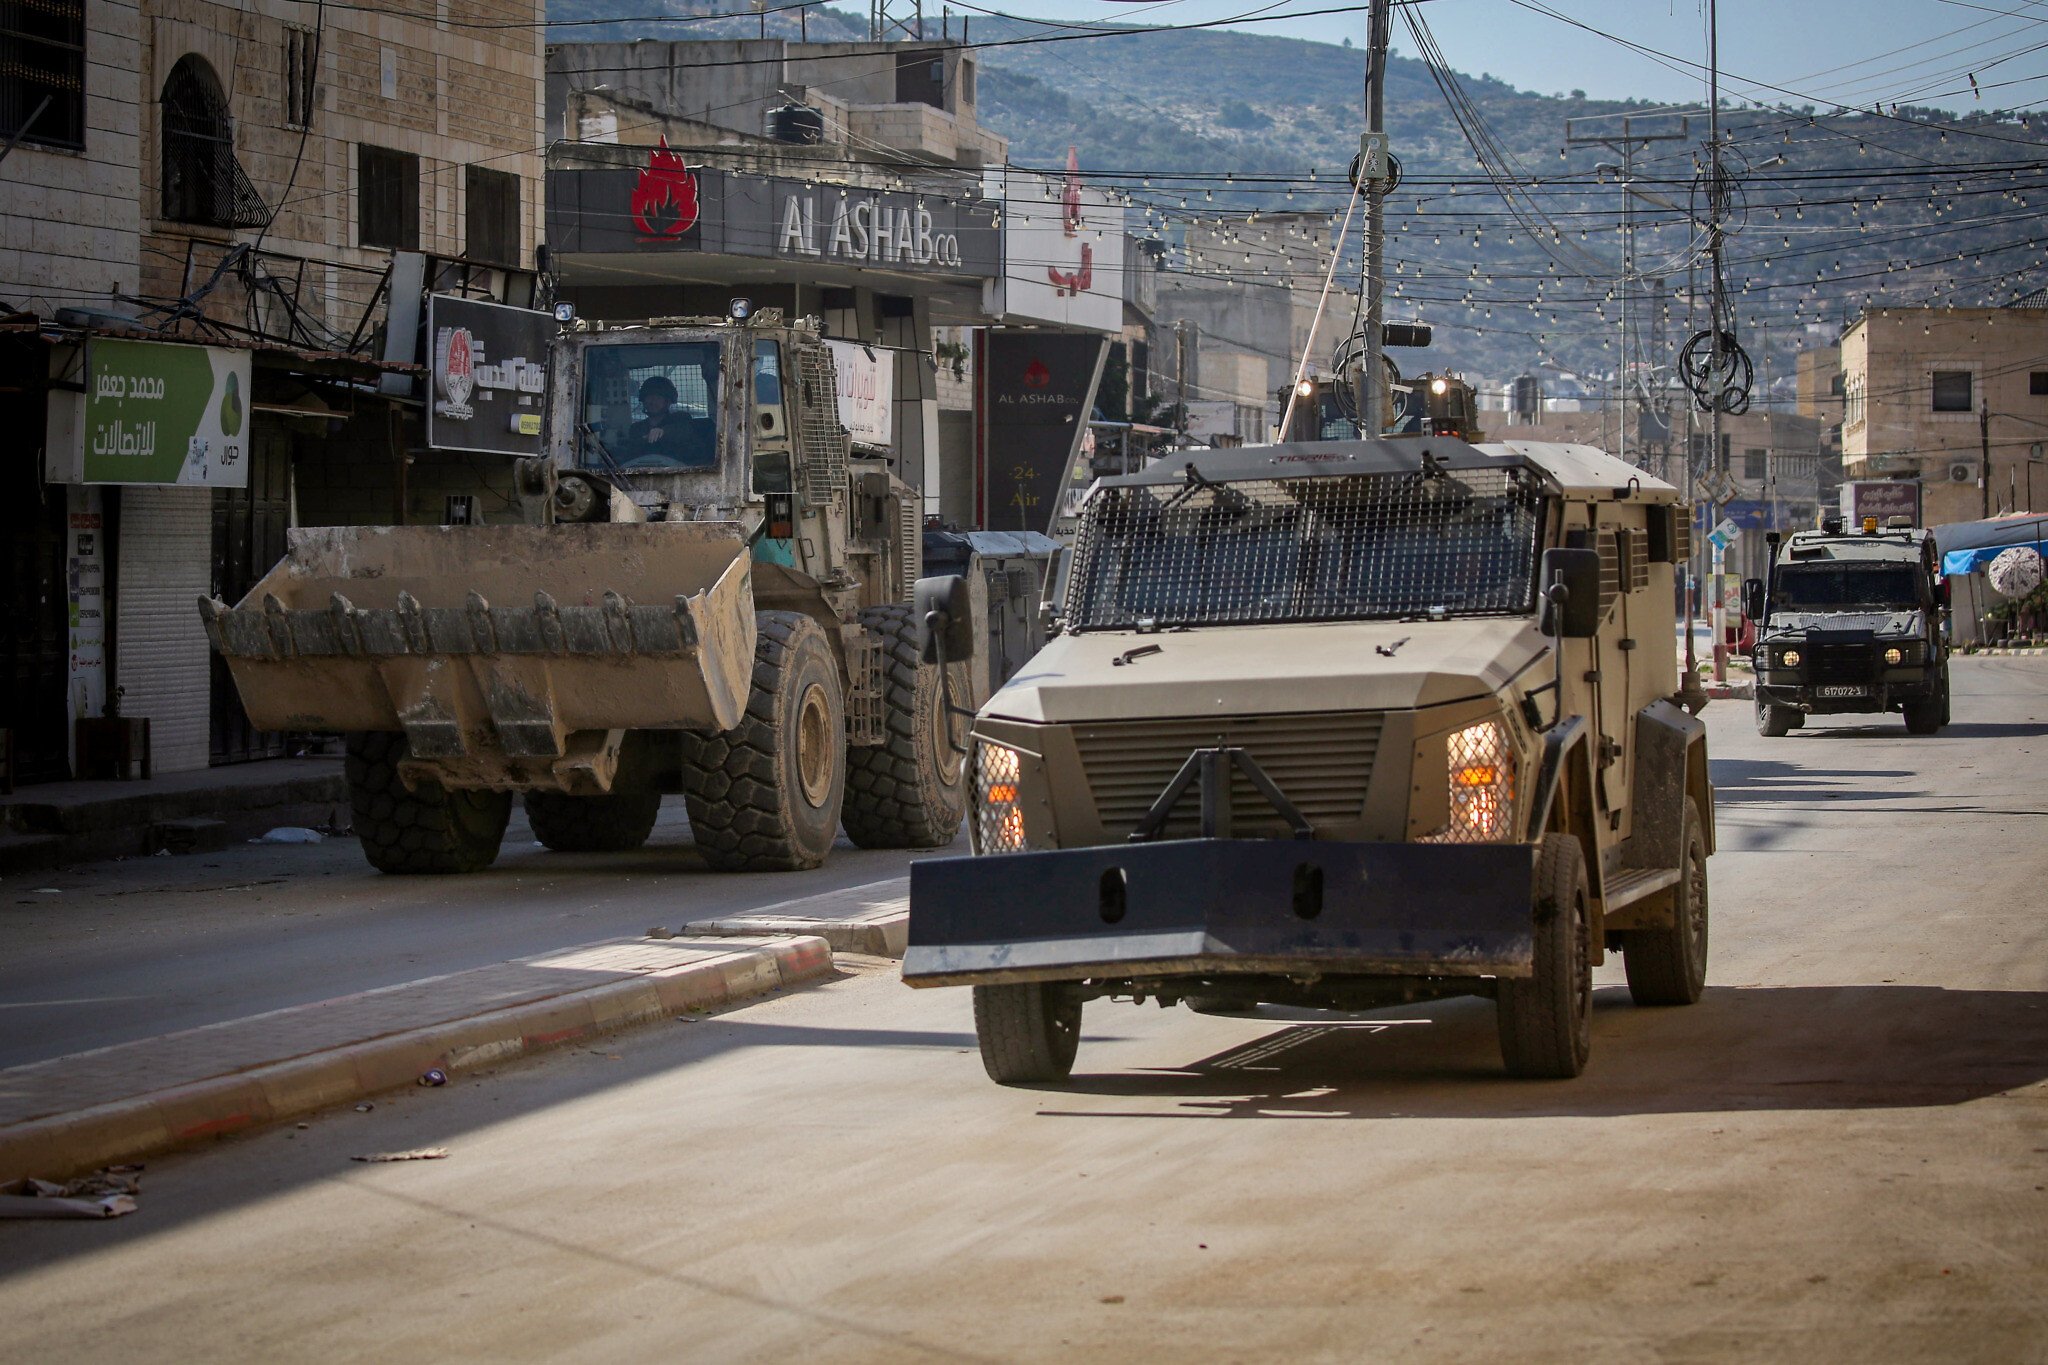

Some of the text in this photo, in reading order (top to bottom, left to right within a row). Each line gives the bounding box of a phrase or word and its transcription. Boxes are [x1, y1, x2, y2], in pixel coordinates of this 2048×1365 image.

[778, 195, 821, 256] AL
[94, 364, 165, 408] محمد جعفر
[998, 394, 1015, 404] AL
[93, 419, 156, 456] للاتصالات
[220, 445, 239, 466] جوال
[1009, 491, 1040, 506] Air
